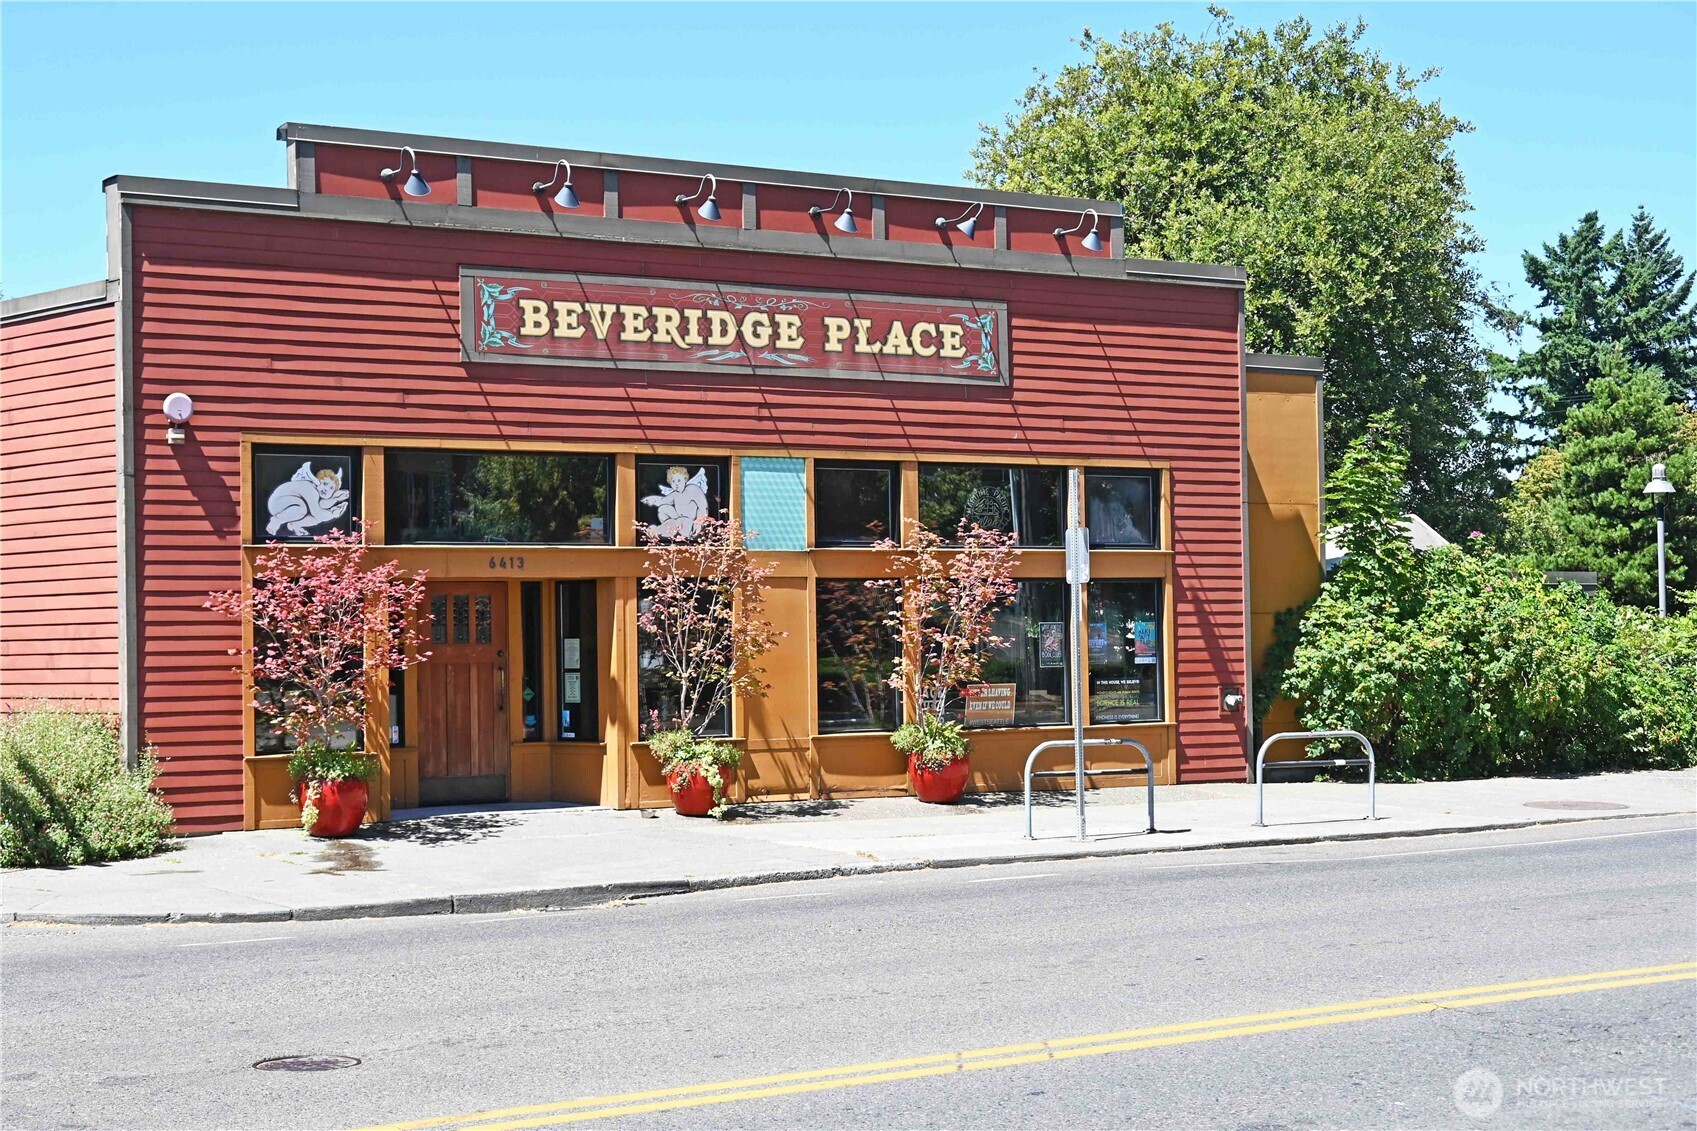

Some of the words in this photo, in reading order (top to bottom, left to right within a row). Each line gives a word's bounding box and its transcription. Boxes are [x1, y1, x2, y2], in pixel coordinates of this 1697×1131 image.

[518, 298, 805, 350] BEVERIDGE
[823, 316, 967, 359] PLACE
[489, 556, 524, 569] 6413
